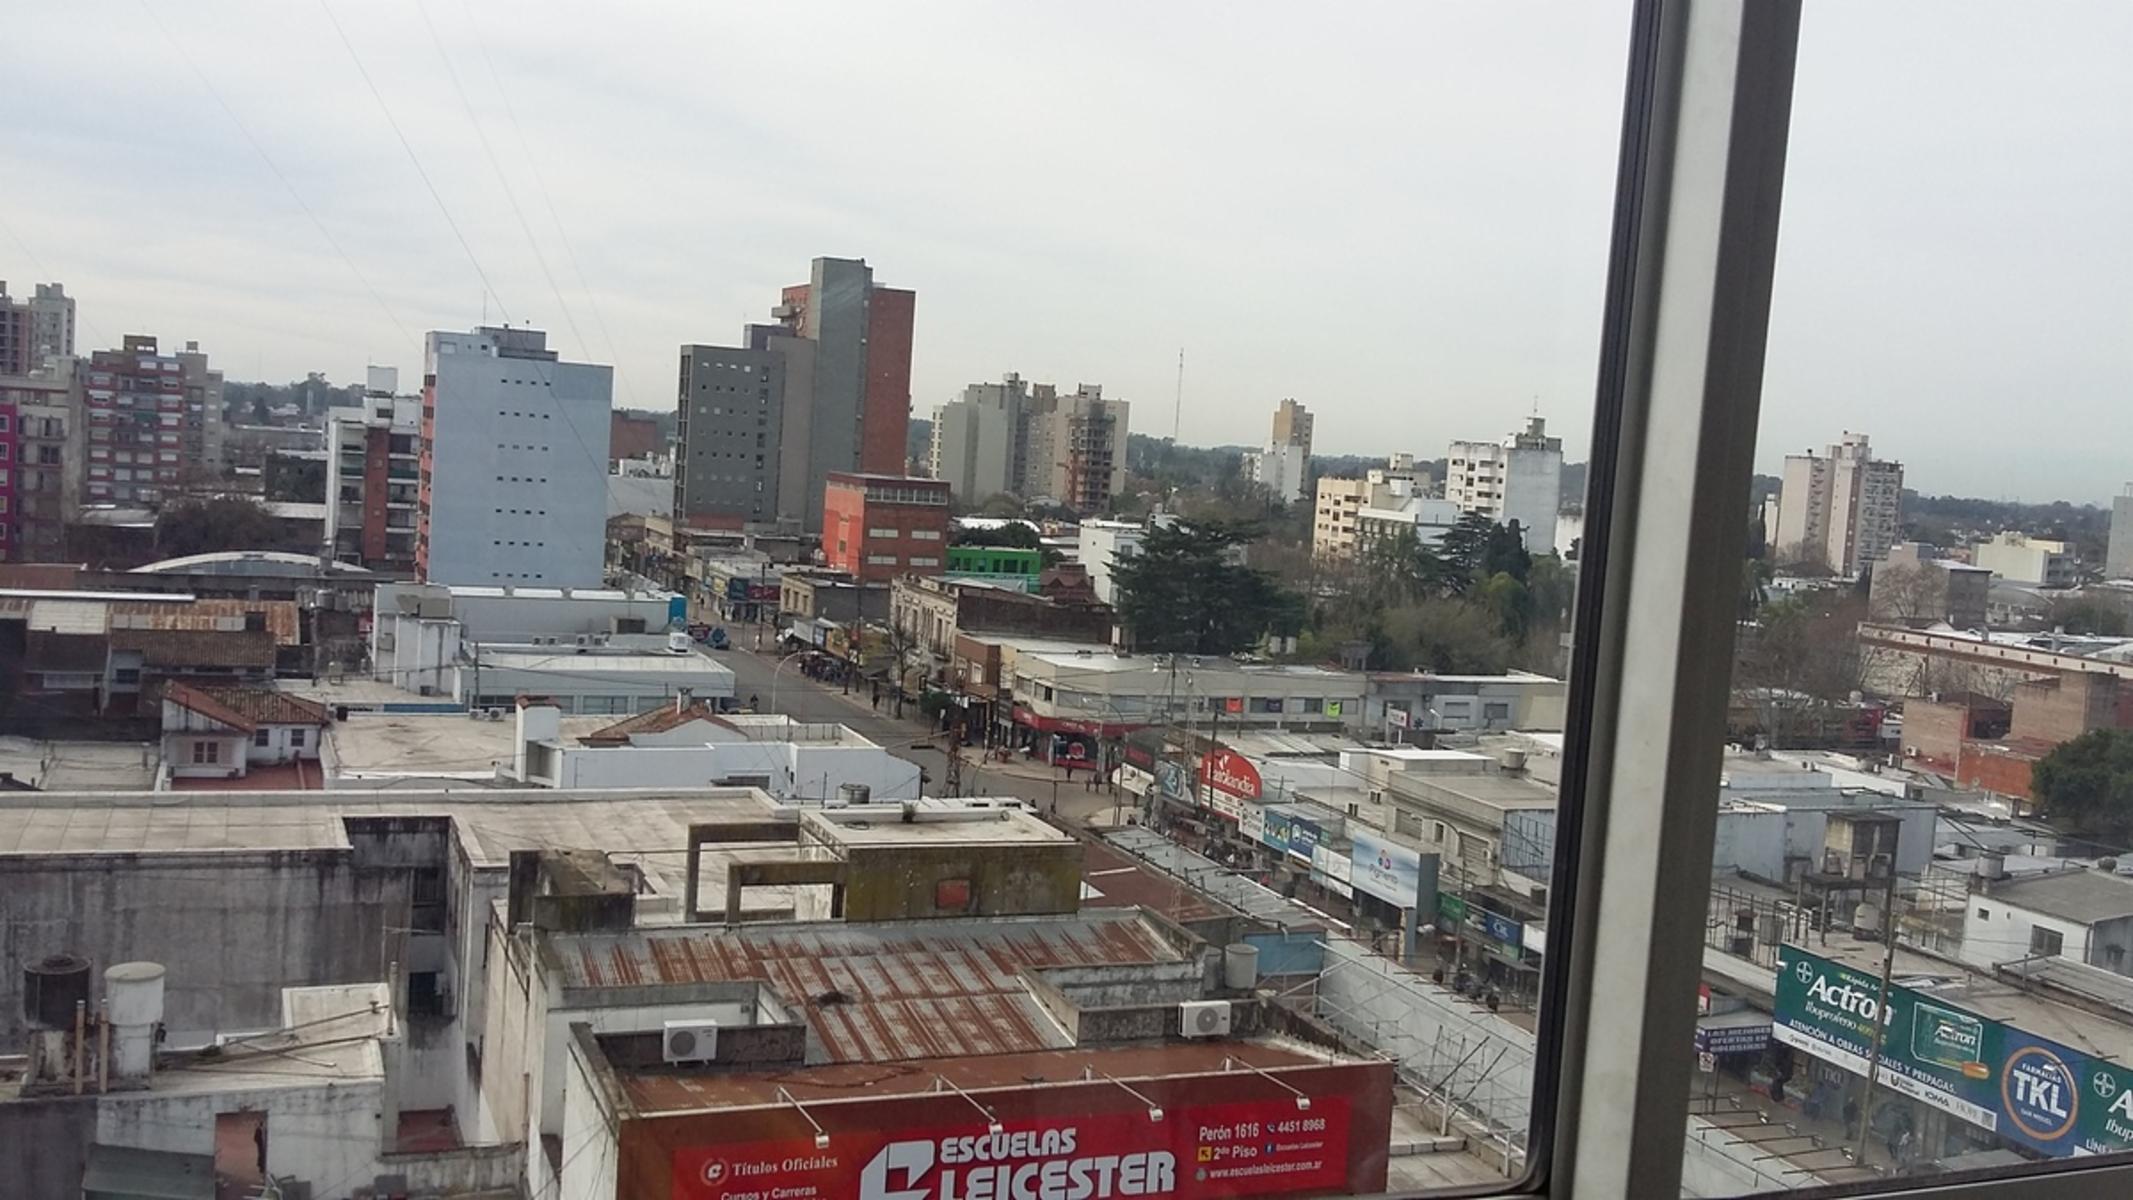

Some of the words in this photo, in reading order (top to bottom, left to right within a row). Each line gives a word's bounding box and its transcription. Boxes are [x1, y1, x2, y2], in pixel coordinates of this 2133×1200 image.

[1806, 974, 1893, 1027] Actron
[1789, 1018, 1828, 1040] ATENCIÓN
[1828, 1034, 1836, 1046] A
[1836, 1038, 1864, 1056] OBRAS
[1904, 1063, 1912, 1075] Y
[2013, 1068, 2067, 1119] TKL
[1199, 1125, 1231, 1141] Perón
[1234, 1122, 1260, 1139] 1616
[1277, 1120, 1301, 1134] 4451
[1302, 1118, 1326, 1132] 8968
[940, 1128, 1077, 1163] ESCUELAS
[1232, 1145, 1258, 1159] Piso
[732, 1162, 778, 1177] Títulos
[782, 1156, 838, 1174] Oficiales
[940, 1151, 1176, 1200] LEICESTER
[721, 1189, 760, 1200] Cursos
[761, 1190, 770, 1200] y
[771, 1185, 817, 1199] Carreras
